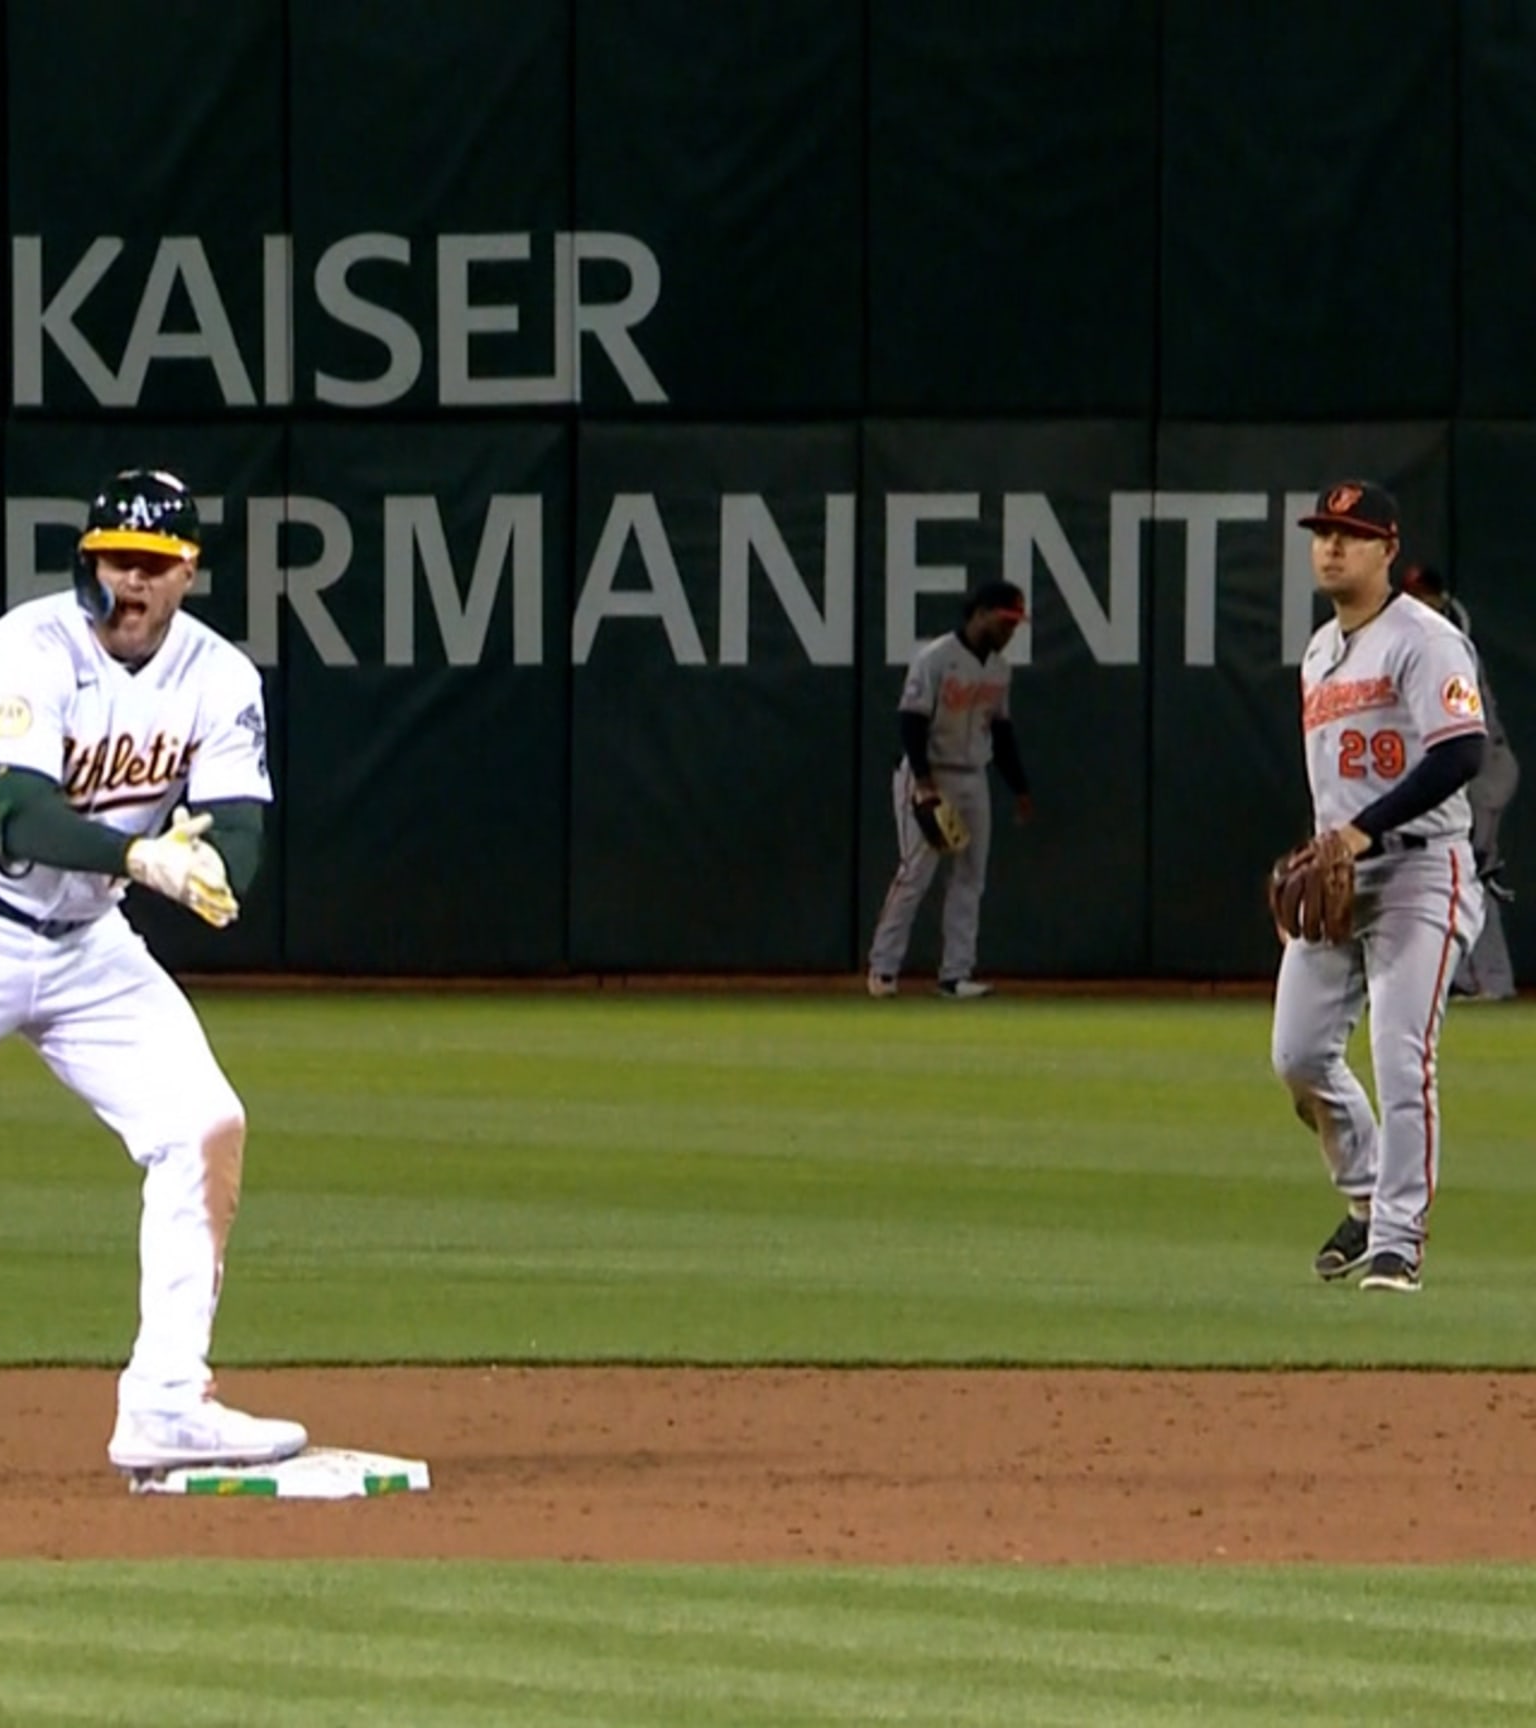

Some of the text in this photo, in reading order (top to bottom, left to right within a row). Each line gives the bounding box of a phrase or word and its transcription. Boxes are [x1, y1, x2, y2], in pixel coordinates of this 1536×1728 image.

[12, 232, 669, 407] KAISER
[5, 491, 1319, 667] PRMANENT
[1339, 729, 1406, 779] 29
